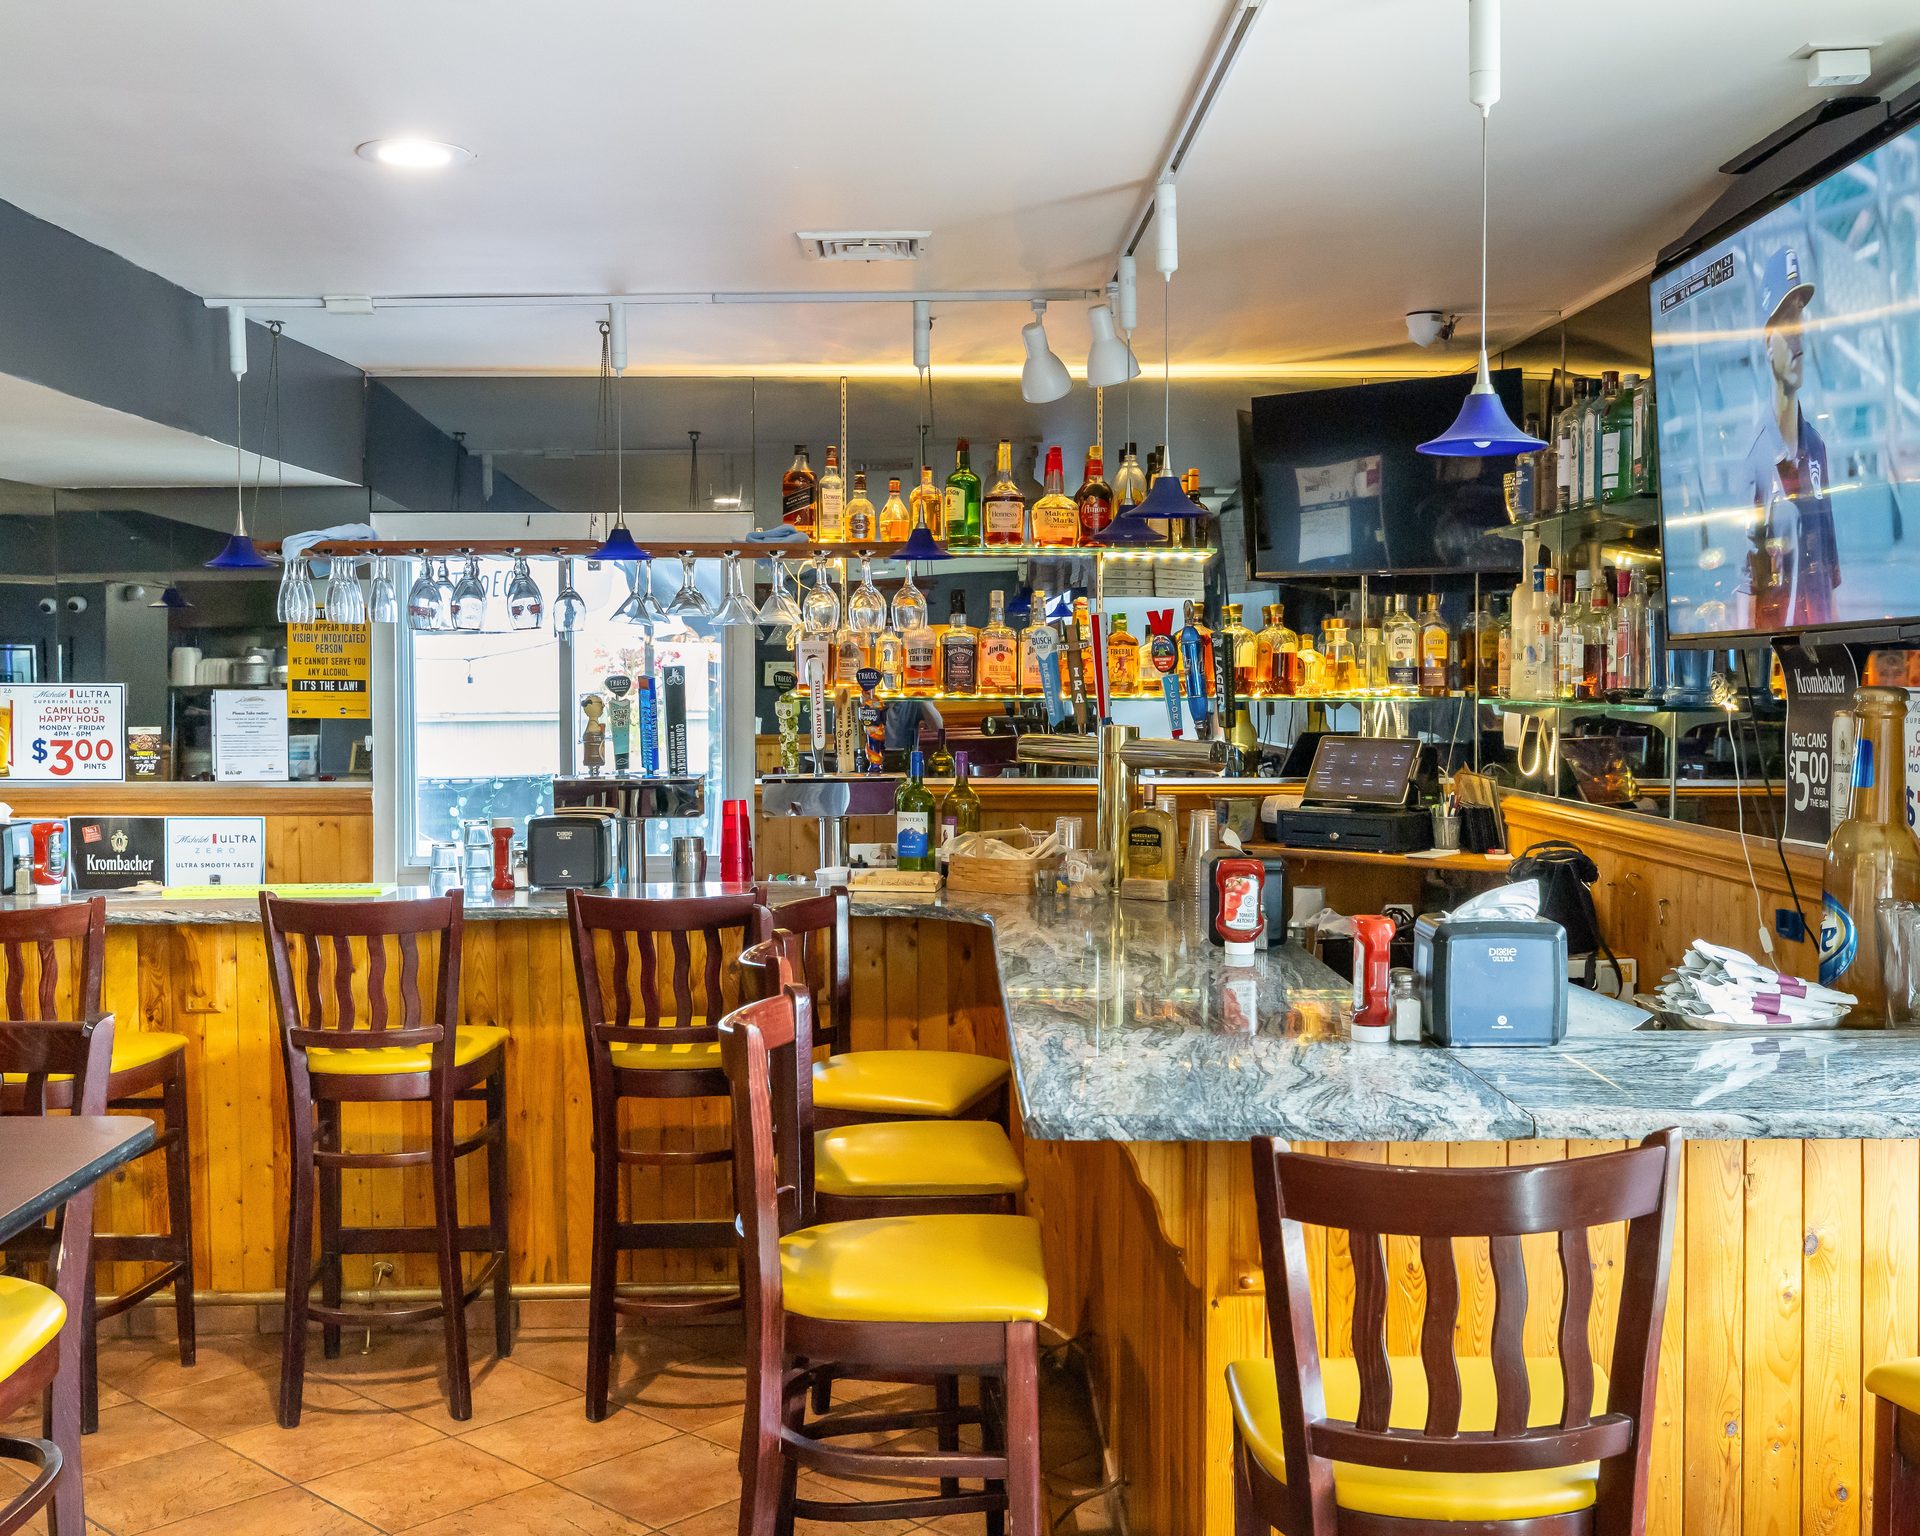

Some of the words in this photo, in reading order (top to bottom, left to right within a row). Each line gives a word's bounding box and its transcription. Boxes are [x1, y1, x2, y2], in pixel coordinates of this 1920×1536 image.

[991, 510, 1018, 519] Hennessy
[315, 624, 339, 632] APPEAR
[352, 624, 360, 632] BE
[362, 624, 367, 632] A
[292, 633, 318, 643] VISIBLY
[321, 633, 366, 643] INTOXICATED
[1031, 636, 1052, 646] BUSCH
[315, 644, 343, 653] PERSON
[908, 647, 934, 655] SOUTHERN
[1110, 648, 1133, 656] FIREBALL
[292, 657, 302, 665] WE
[304, 657, 329, 666] CANNOT
[331, 657, 351, 666] SERVE
[354, 657, 366, 666] YOU
[307, 668, 320, 676] ANY
[300, 680, 316, 691] IT'S
[320, 680, 336, 691] THE
[338, 680, 358, 691] LAW!
[1073, 667, 1084, 703] IPA
[1215, 656, 1226, 707] LAGER
[1794, 667, 1846, 694] Krombacher
[76, 690, 110, 698] ULTRA
[1042, 662, 1050, 688] BUSCH
[1046, 690, 1055, 717] LIGHT
[1167, 677, 1180, 728] VICTORY
[45, 706, 100, 714] CAMILLO'S
[39, 715, 73, 723] HAPPY
[76, 715, 105, 723] HOUR
[1791, 732, 1805, 747] 16oz
[1807, 733, 1827, 748] CANS
[675, 723, 687, 776] CONSHOHOCKEN
[1813, 787, 1826, 796] OVER
[1810, 798, 1818, 807] THE
[1819, 799, 1829, 809] BAR
[220, 834, 257, 844] ULTRA
[86, 853, 154, 872] Krombacher
